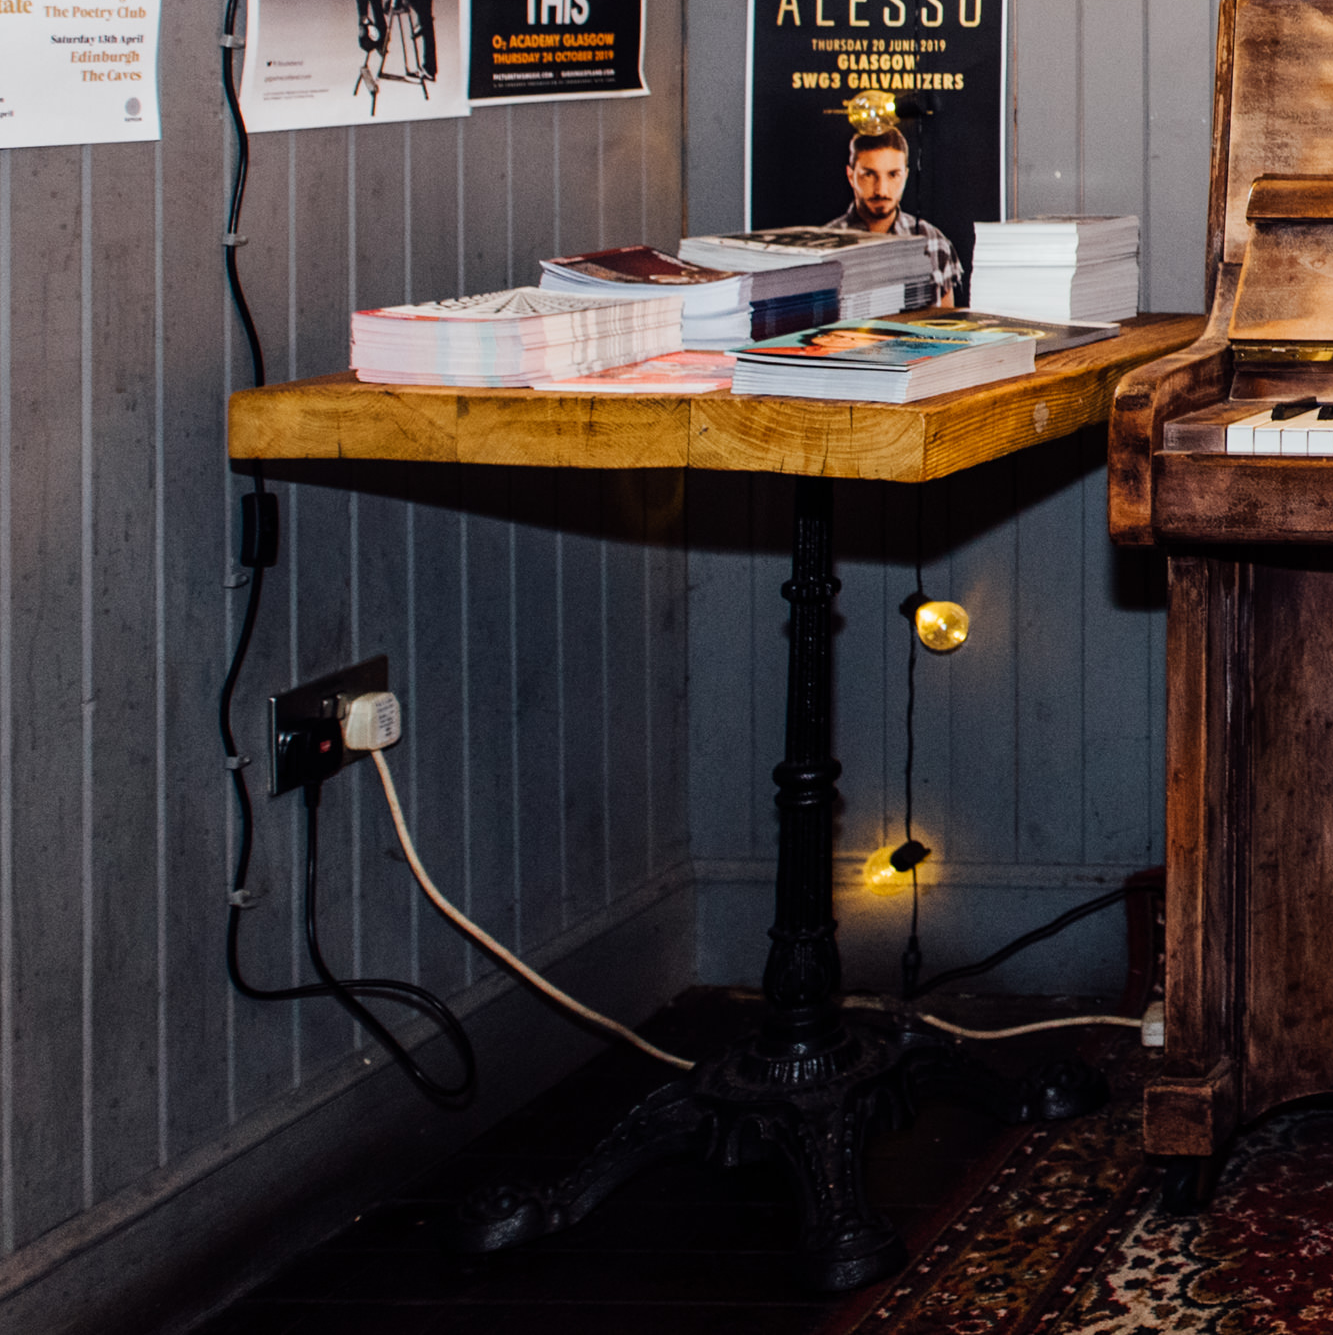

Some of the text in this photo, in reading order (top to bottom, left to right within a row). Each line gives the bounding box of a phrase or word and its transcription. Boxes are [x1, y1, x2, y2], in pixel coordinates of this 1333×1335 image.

[44, 6, 146, 21] The Poetry Club
[812, 39, 946, 52] THURSDAY 20 JUNE 2019
[71, 51, 140, 64] Edinburgh
[837, 55, 920, 70] GLASGOW
[82, 69, 141, 82] The Caves
[792, 73, 964, 90] SWG3 GALVANIZERS
